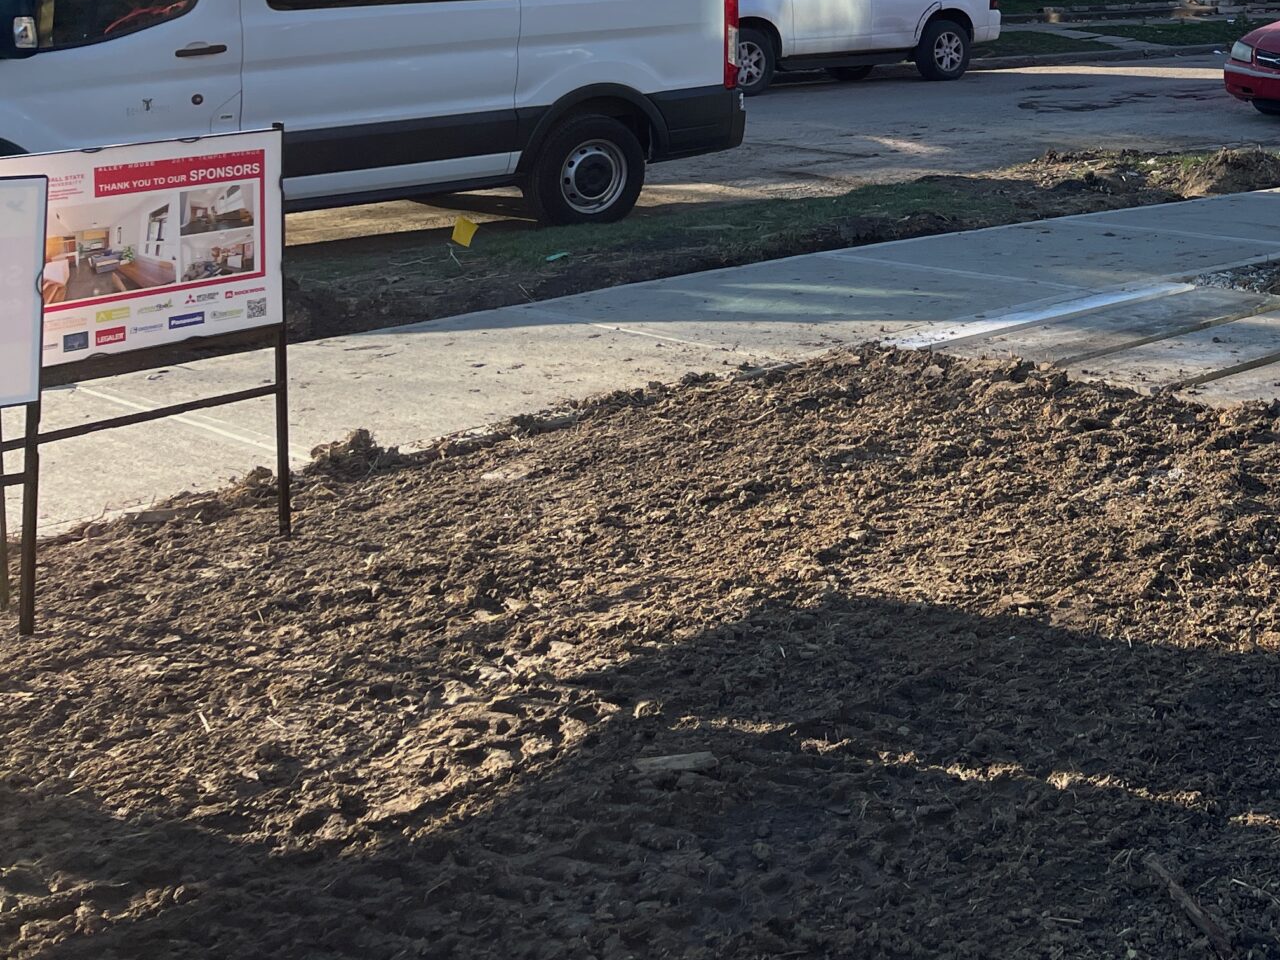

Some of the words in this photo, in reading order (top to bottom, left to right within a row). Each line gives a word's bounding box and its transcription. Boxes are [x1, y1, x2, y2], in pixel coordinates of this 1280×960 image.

[98, 182, 130, 192] THANK
[132, 179, 151, 188] YOU
[154, 177, 165, 185] TO
[167, 174, 187, 184] OUR
[189, 163, 261, 181] SPONSORS
